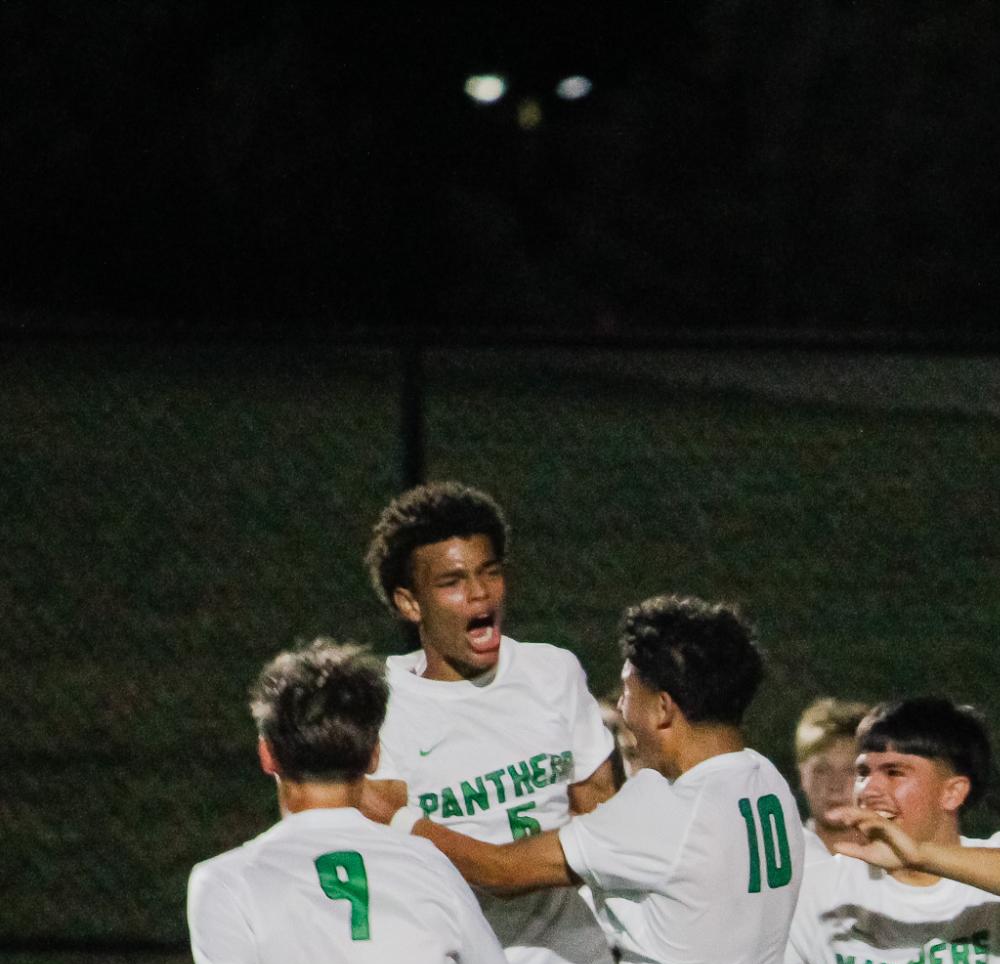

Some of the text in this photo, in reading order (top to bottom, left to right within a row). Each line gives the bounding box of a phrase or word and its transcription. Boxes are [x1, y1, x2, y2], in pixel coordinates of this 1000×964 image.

[507, 801, 541, 841] 5
[738, 793, 792, 893] 10
[313, 851, 370, 940] 9
